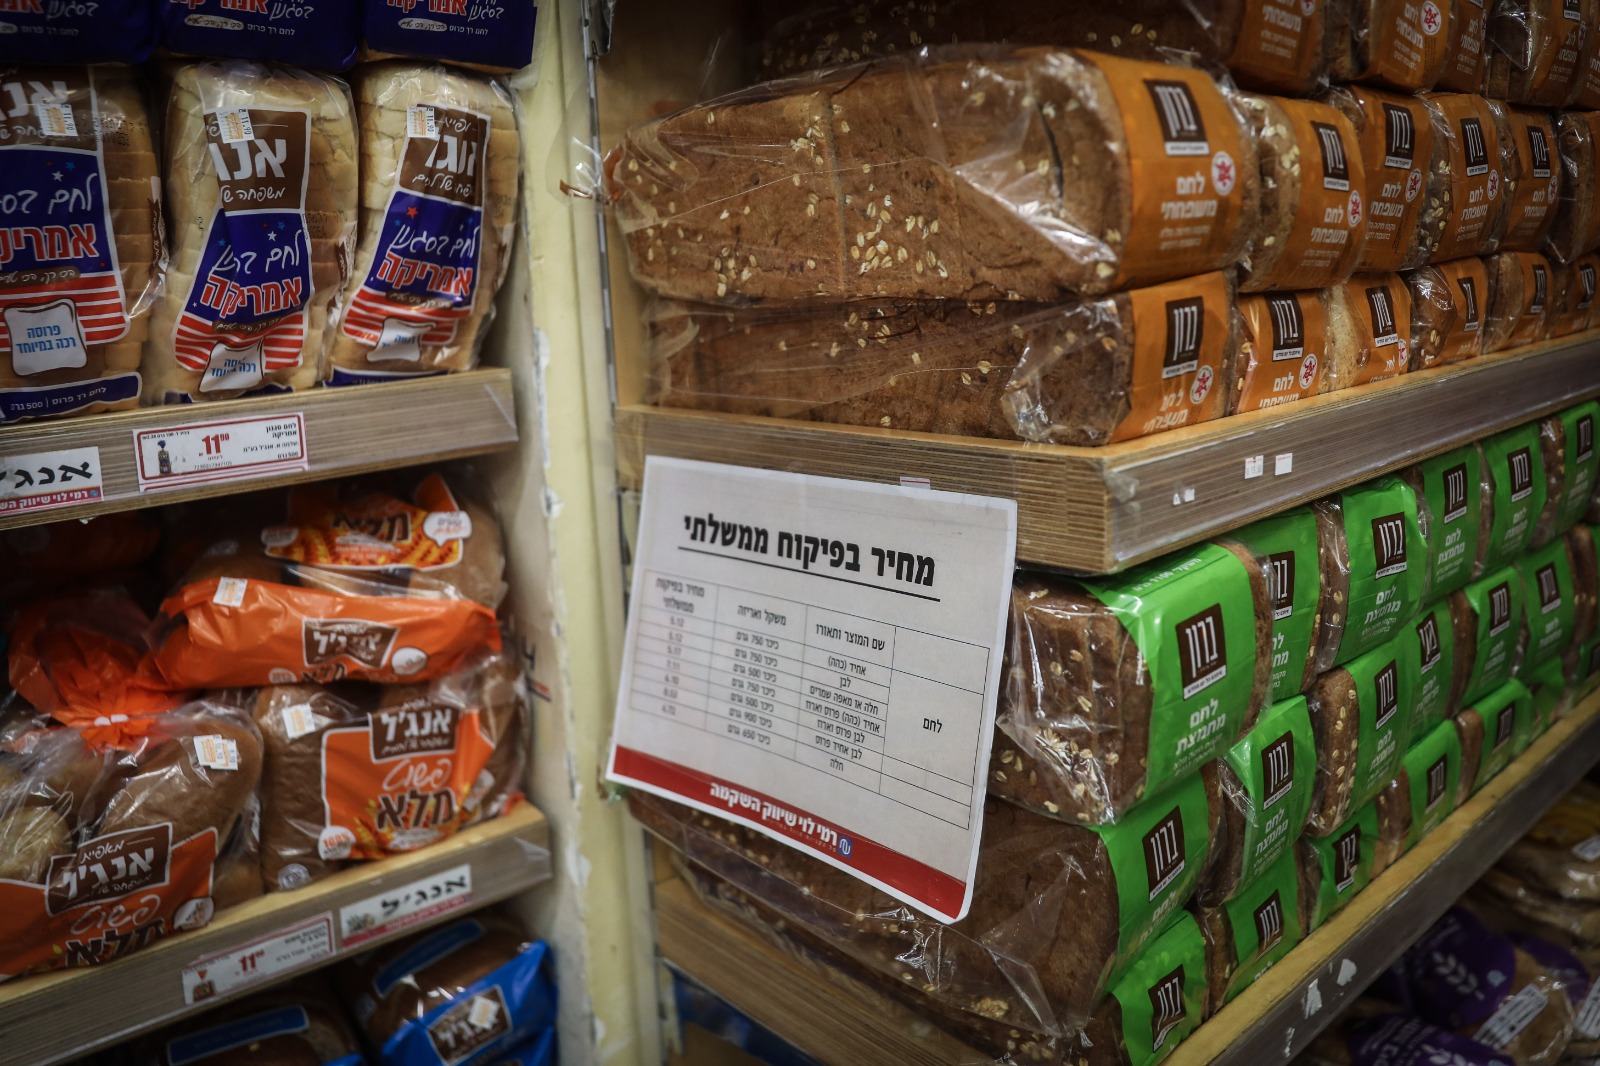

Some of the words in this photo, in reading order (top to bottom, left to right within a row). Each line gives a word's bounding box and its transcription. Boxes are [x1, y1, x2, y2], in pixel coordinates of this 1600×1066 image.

[1176, 171, 1207, 195] לחם
[1382, 181, 1402, 198] לחם
[48, 173, 97, 214] לחם
[236, 187, 285, 202] משפחה
[1469, 185, 1484, 204] לחם
[1532, 188, 1546, 202] לחם
[1161, 199, 1217, 220] משפחתי
[1324, 205, 1344, 224] לחם
[1370, 201, 1404, 217] משפחתי
[450, 226, 480, 258] לחם
[1310, 227, 1348, 244] משפחתי
[265, 229, 302, 273] לחם
[377, 252, 473, 296] אמריקה
[27, 325, 61, 338] פרוסה
[16, 341, 53, 353] במיוחד
[56, 337, 77, 349] רכה
[1273, 373, 1294, 392] לחם
[76, 392, 87, 401] רך
[89, 387, 107, 397] לחם
[26, 402, 43, 410] 500
[52, 395, 74, 405] פרוס
[52, 492, 67, 502] לוי
[69, 490, 88, 499] רמי
[19, 495, 51, 509] שיווק
[684, 513, 769, 554] ממשלתי
[1445, 528, 1461, 547] לחם
[777, 531, 861, 572] בפיקוח
[1438, 542, 1465, 565] מחמצת
[871, 547, 935, 587] מחיר
[1376, 585, 1396, 605] לחם
[737, 605, 761, 620] ואריזה
[764, 609, 786, 626] משקל
[1364, 600, 1401, 625] מחמצת
[736, 631, 748, 642] גרם
[816, 623, 842, 640] ותאורו
[844, 629, 869, 647] המוצר
[751, 634, 763, 646] 750
[765, 639, 779, 650] כיכר
[871, 639, 885, 650] שם
[735, 648, 747, 659] גרם
[750, 651, 762, 663] 750
[764, 656, 778, 667] כיכר
[828, 656, 847, 671] (כהה)
[733, 663, 746, 674] גרם
[748, 667, 761, 678] 500
[849, 662, 866, 676] אחיד
[731, 678, 744, 688] גרם
[763, 671, 777, 683] כיכר
[840, 676, 852, 688] לבן
[747, 681, 760, 693] 750
[762, 686, 775, 697] כיכר
[810, 686, 831, 699] שמרים
[730, 692, 743, 703] גרם
[833, 693, 852, 706] מאפה
[805, 700, 822, 713] וארוז
[855, 699, 862, 710] או
[864, 702, 878, 715] חלה
[729, 708, 741, 718] גרם
[824, 706, 840, 719] פרוס
[842, 711, 860, 727] (כהה)
[1190, 698, 1219, 729] לחם
[380, 708, 452, 742] אנג'ל
[727, 724, 740, 735] גרם
[817, 719, 834, 732] וארוז
[863, 720, 880, 733] אחיד
[923, 717, 943, 733] לחם
[836, 726, 852, 739] פרוס
[853, 732, 865, 743] לבן
[1176, 713, 1226, 756] מחמצת
[815, 735, 831, 748] פרוס
[833, 742, 849, 755] אחיד
[851, 748, 862, 760] לבן
[830, 758, 844, 771] חלה
[710, 783, 761, 812] השקמה
[377, 789, 456, 832] מלא
[762, 802, 796, 826] שיווק
[798, 816, 816, 835] לוי
[1265, 807, 1285, 834] לחם
[817, 824, 837, 846] רמי
[1255, 819, 1289, 857] מחמצת
